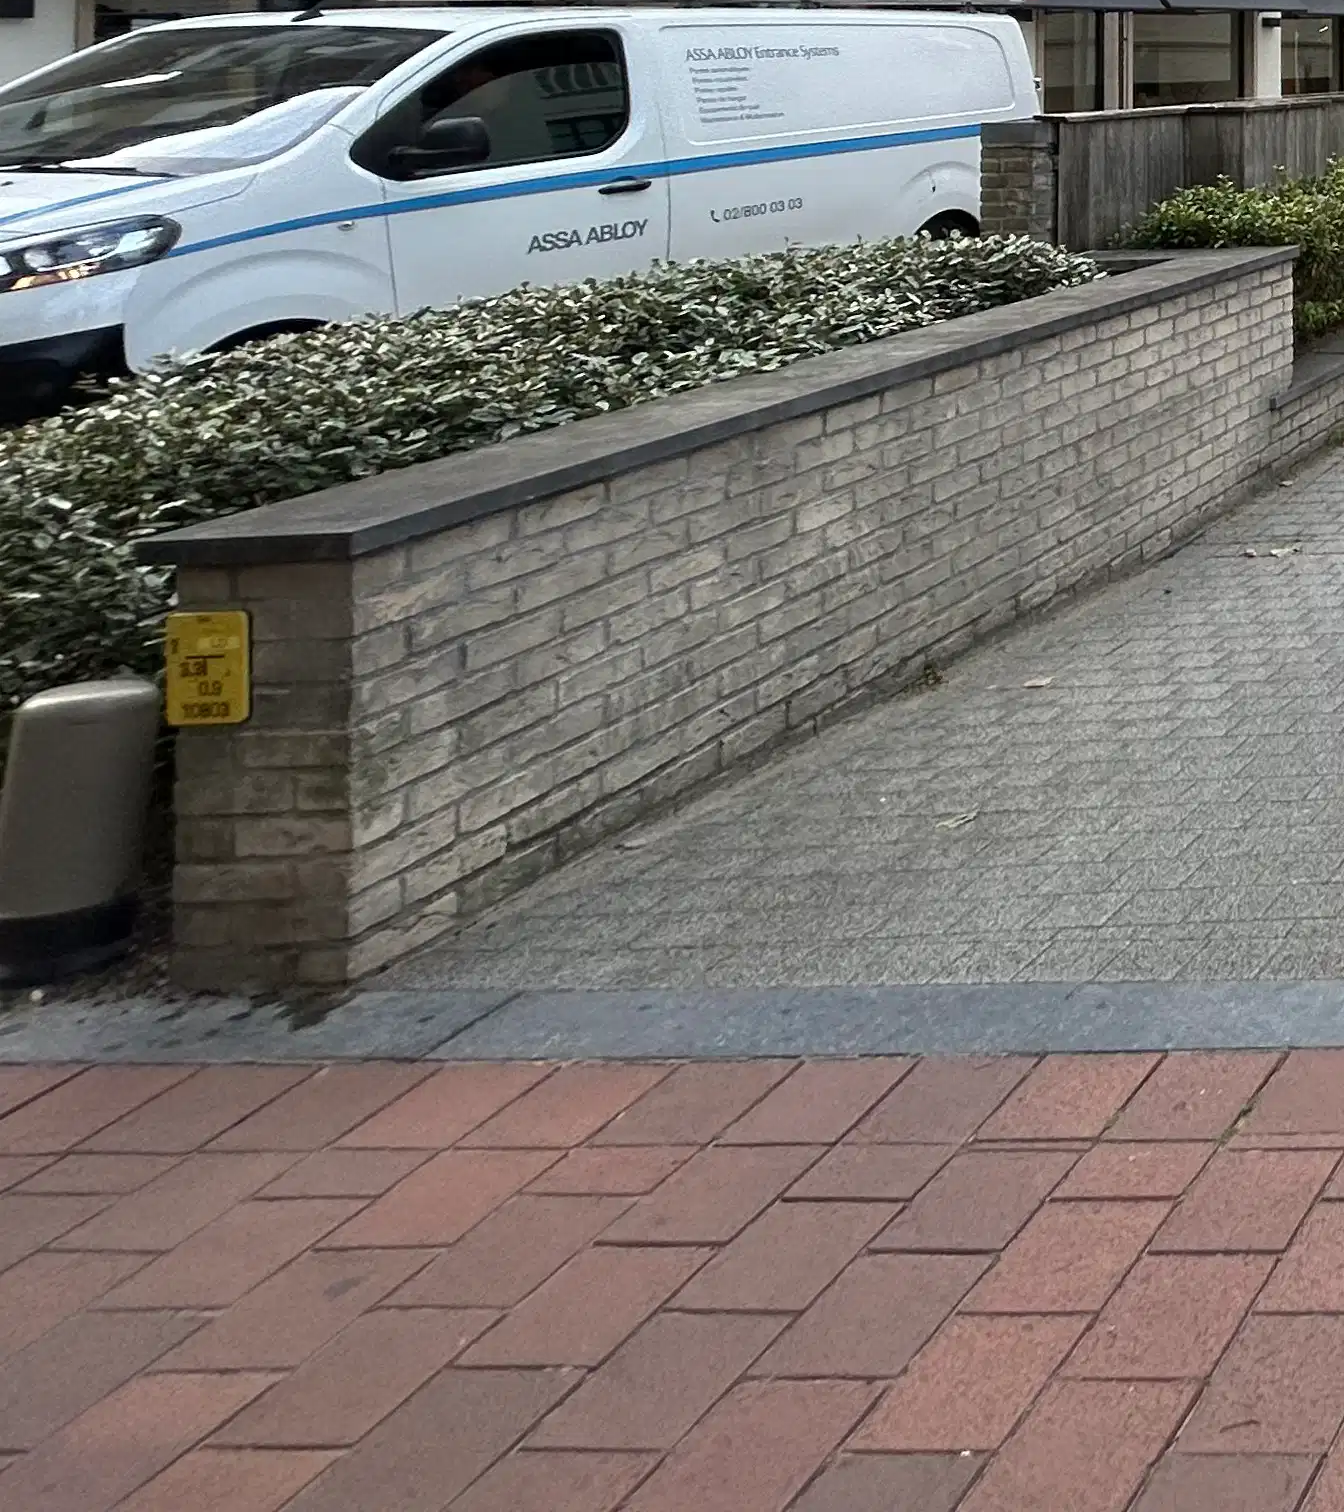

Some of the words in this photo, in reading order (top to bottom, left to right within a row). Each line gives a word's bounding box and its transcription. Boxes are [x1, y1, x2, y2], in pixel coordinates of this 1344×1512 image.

[686, 48, 717, 61] ASSA
[717, 46, 752, 60] ABLOY
[754, 46, 799, 59] Entrance
[799, 44, 840, 60] Systems
[722, 204, 767, 221] 02/800
[770, 200, 785, 214] 03
[787, 197, 803, 210] 03
[527, 228, 583, 255] ASSA
[585, 218, 649, 246] ABLOY
